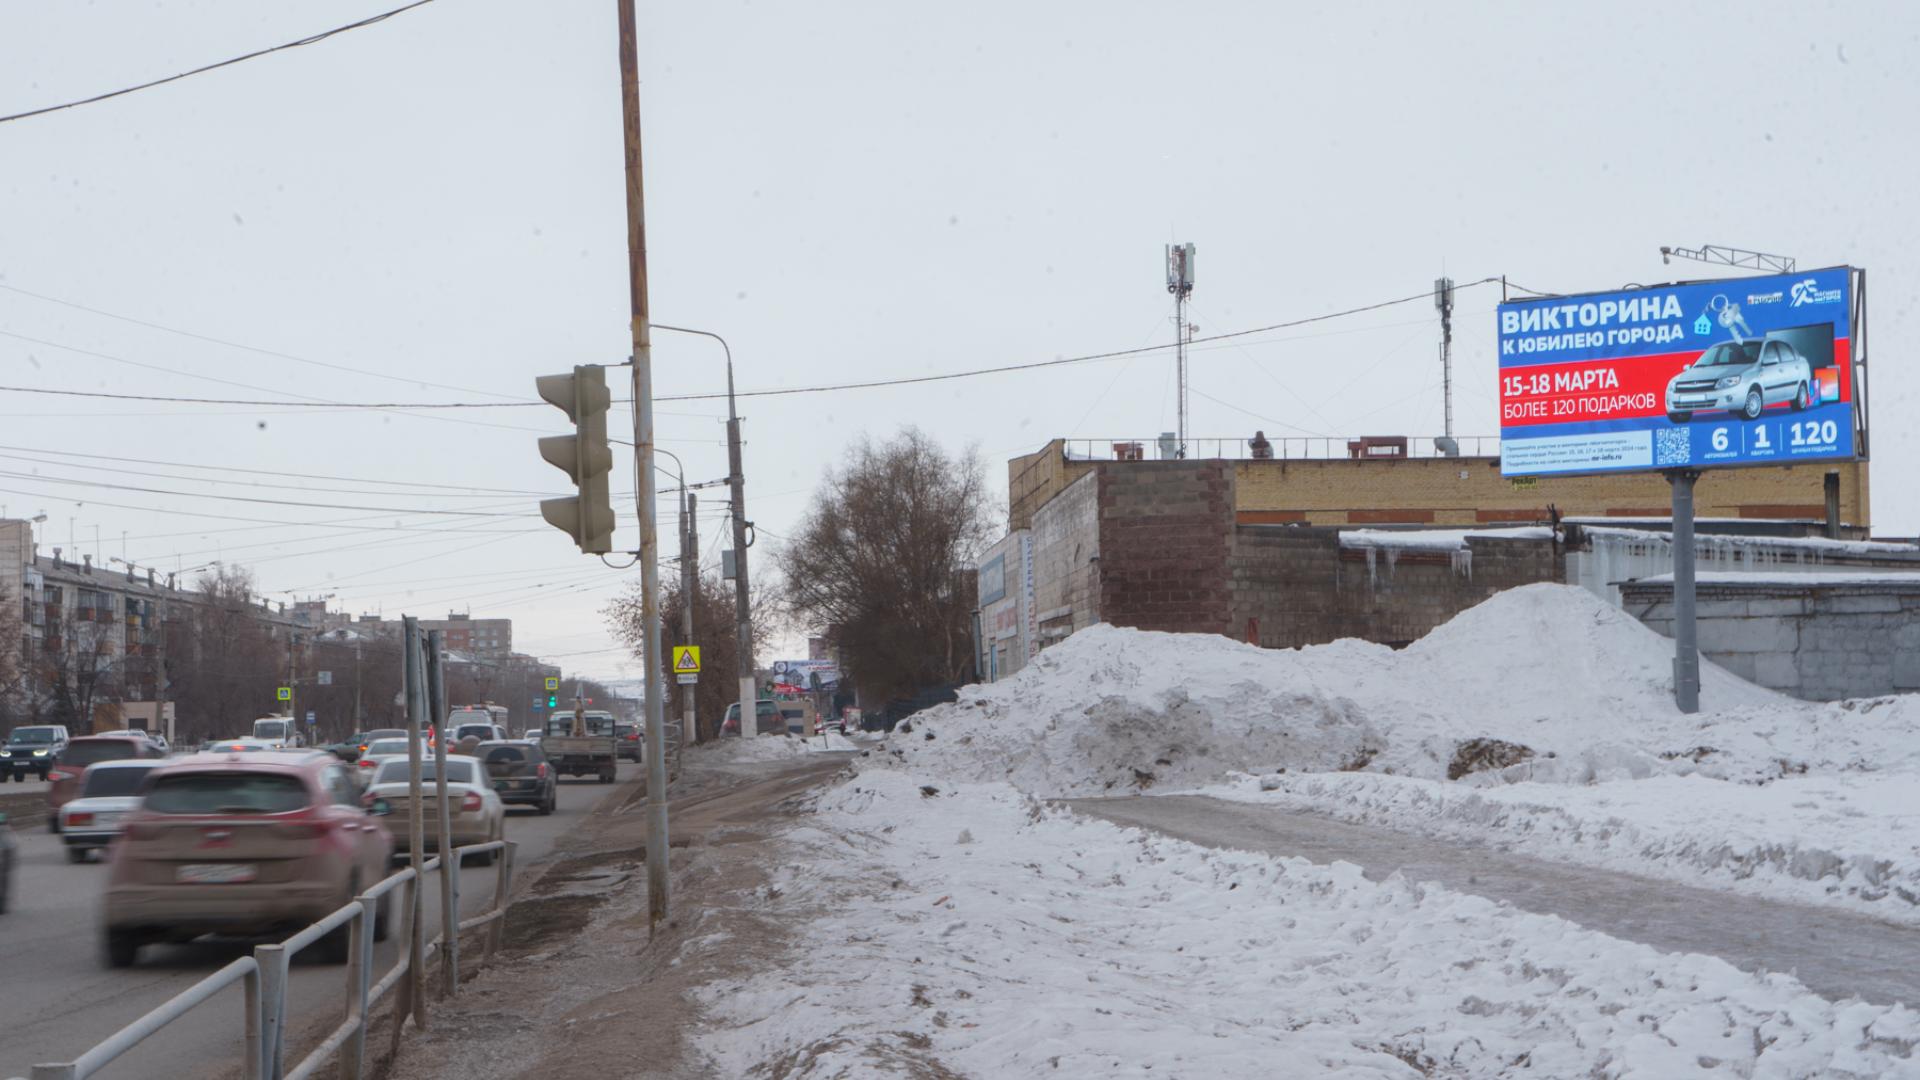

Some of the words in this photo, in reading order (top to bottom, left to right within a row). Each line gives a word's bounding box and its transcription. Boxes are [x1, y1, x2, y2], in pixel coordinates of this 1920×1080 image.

[1502, 295, 1683, 334] ВИКТОРИНА
[1503, 339, 1515, 355] К
[1518, 330, 1604, 354] ЮБИЛЕЮ
[1607, 324, 1684, 345] ГОРОДА
[1503, 373, 1550, 396] 15-18
[1555, 368, 1619, 392] МАРТА
[1504, 400, 1548, 418] БОЛЕЕ
[1552, 399, 1576, 415] 120
[1578, 393, 1656, 414] ПОДАРКОВ
[1711, 427, 1729, 451] 6
[1755, 424, 1771, 448] 1
[1790, 420, 1837, 446] 120
